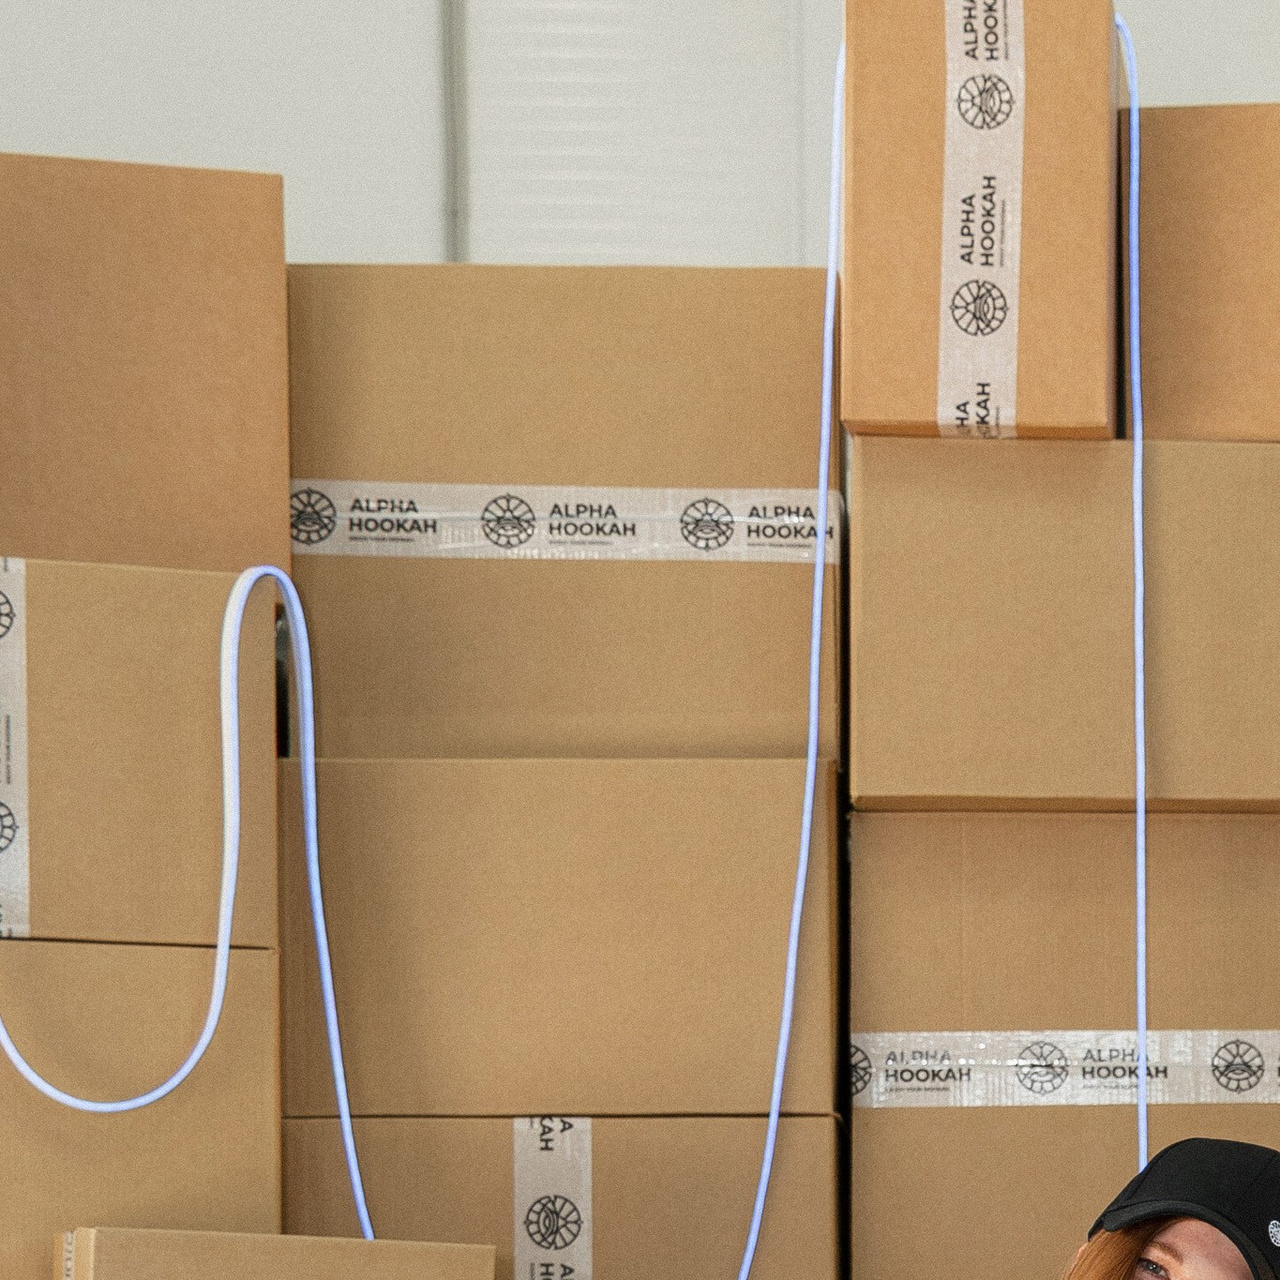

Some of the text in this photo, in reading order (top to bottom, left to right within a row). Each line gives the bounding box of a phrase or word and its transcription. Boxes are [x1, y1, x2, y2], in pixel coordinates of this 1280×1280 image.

[964, 0, 979, 60] ALPH
[960, 194, 975, 265] ALPHA
[980, 176, 996, 267] HOOKAH
[350, 498, 419, 514] ALPHA
[549, 503, 617, 519] ALPHA
[749, 505, 816, 519] ALPHA
[349, 517, 438, 534] HOOKAH
[549, 521, 637, 537] HOOKAH
[885, 1068, 971, 1083] HOOKAH
